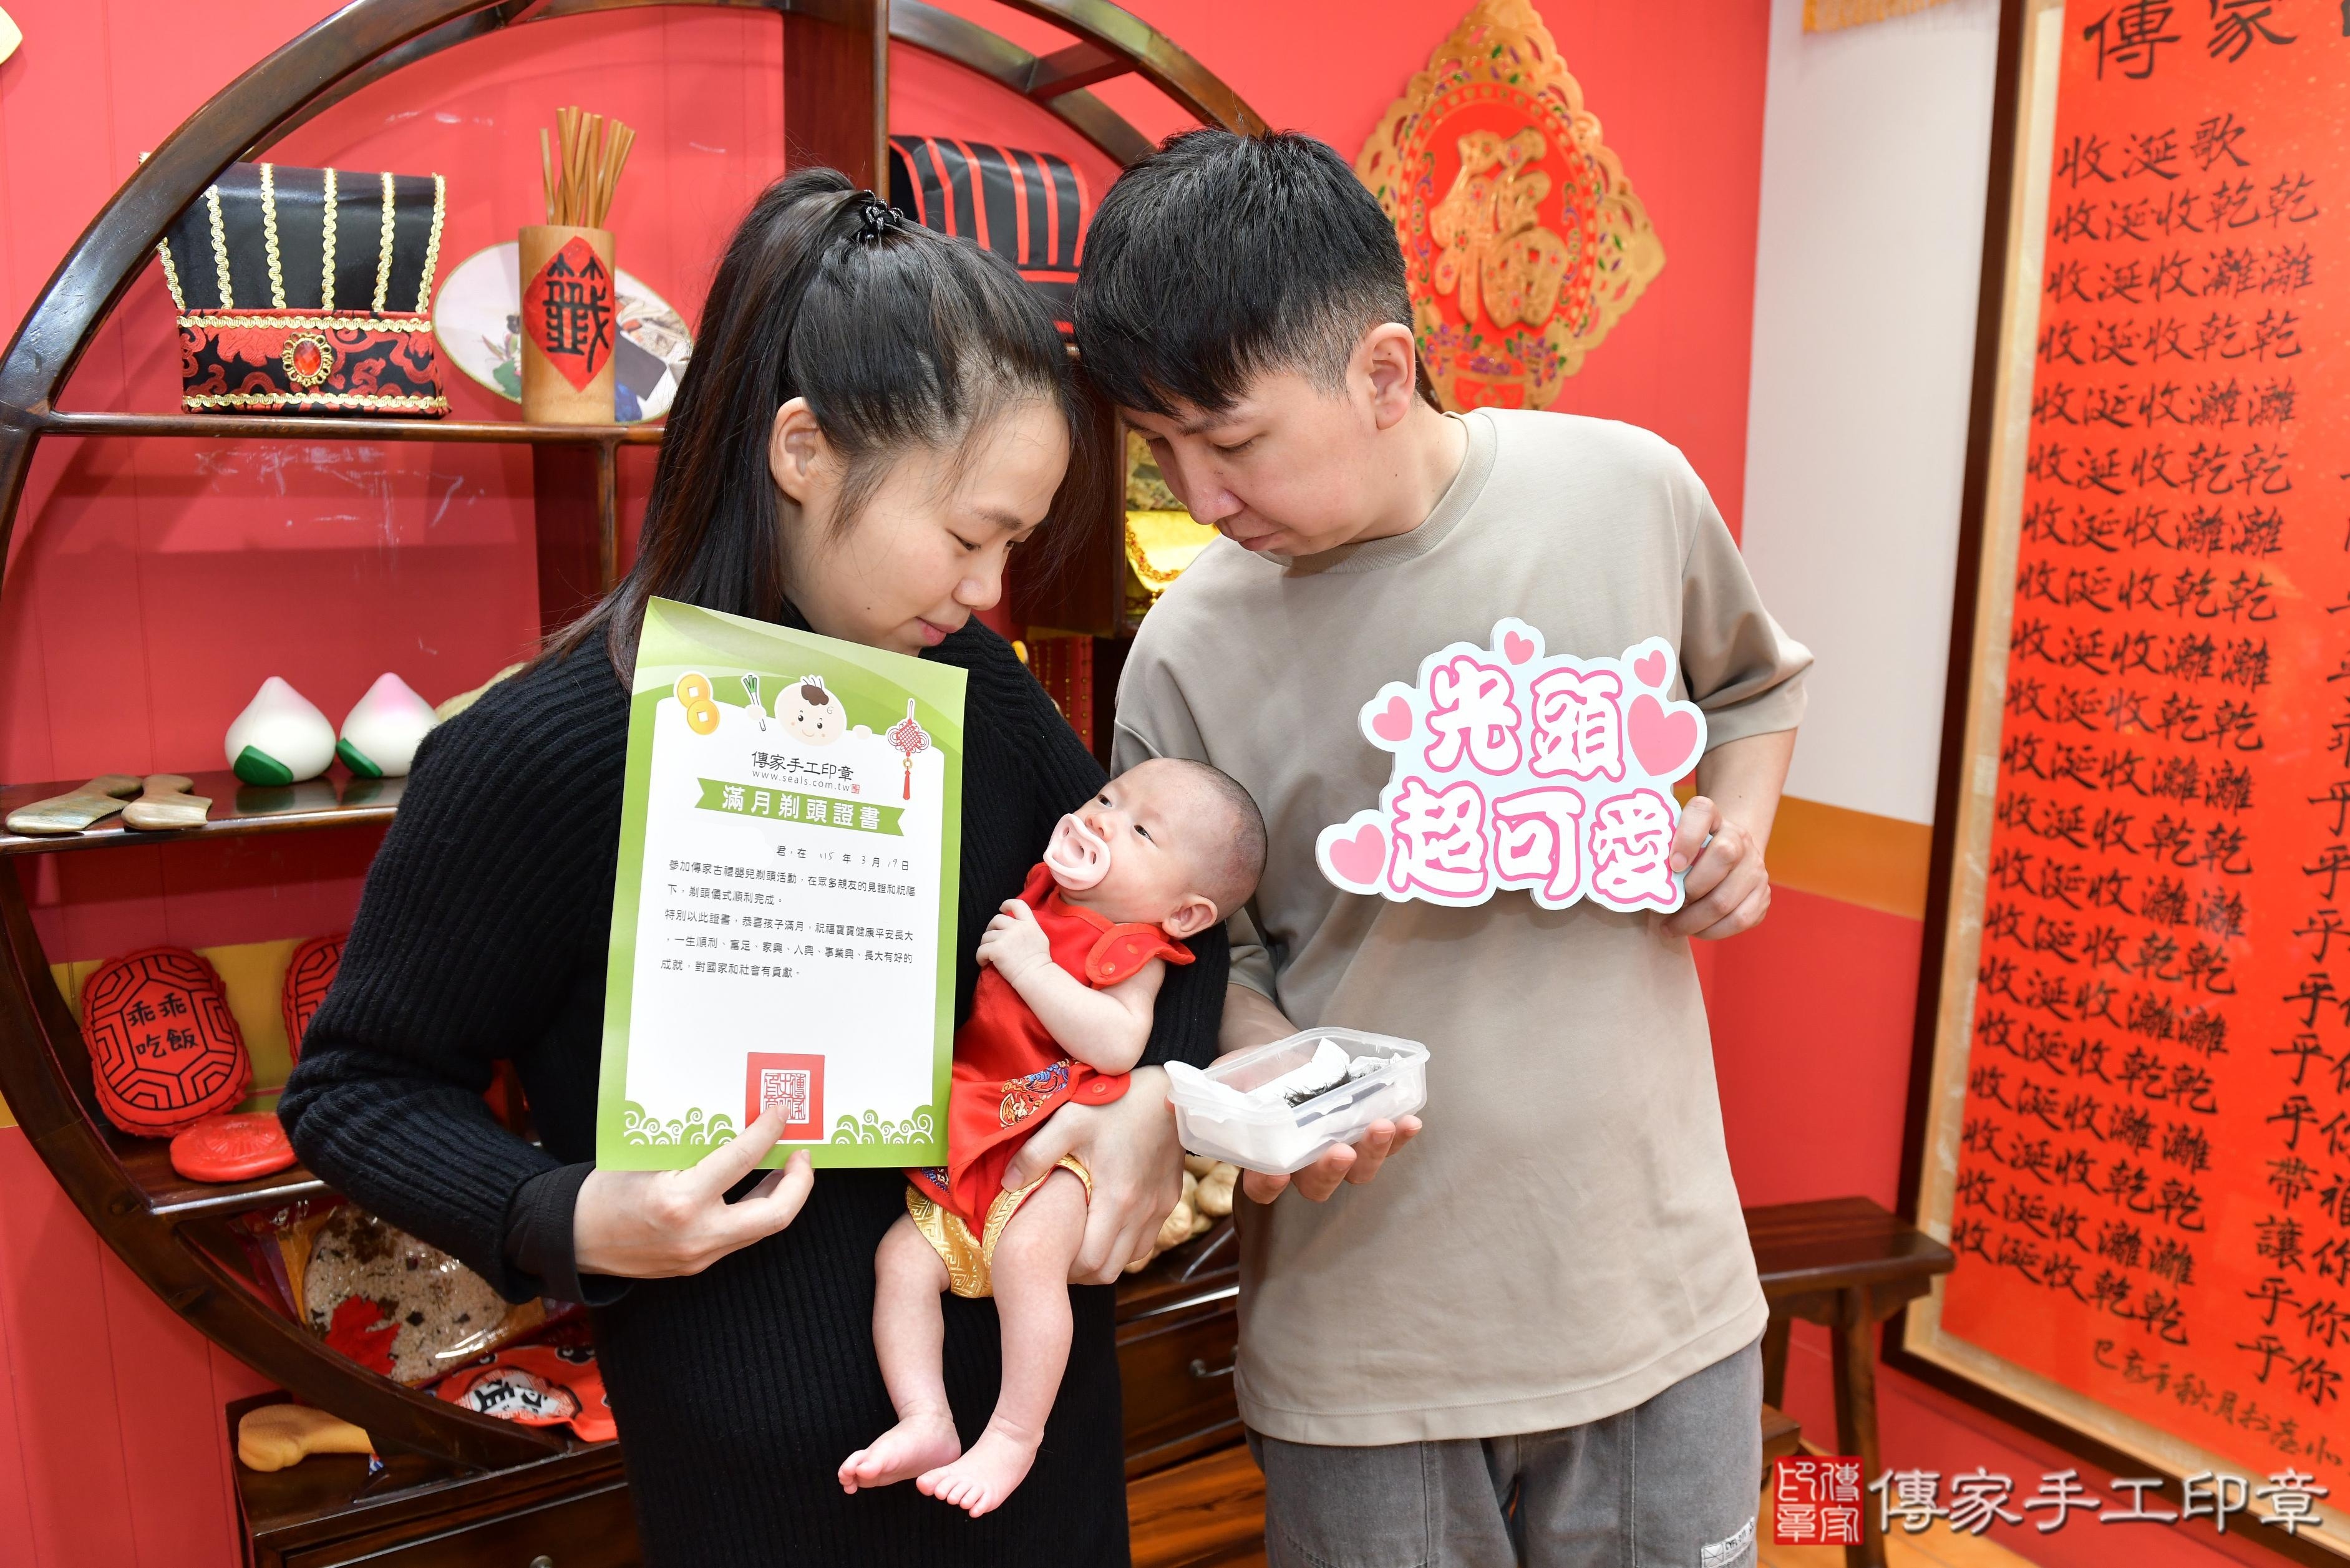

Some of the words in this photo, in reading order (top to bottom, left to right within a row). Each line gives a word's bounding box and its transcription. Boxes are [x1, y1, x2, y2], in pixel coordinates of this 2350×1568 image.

[2084, 0, 2350, 80] 傳家
[2059, 114, 2250, 188] 收涎歌
[1430, 126, 1568, 329] 福
[2055, 173, 2319, 241] 收涎收乾乾
[2038, 309, 2303, 365] 收涎收乾乾
[2027, 442, 2293, 496] 收涎收乾乾
[2017, 560, 2278, 622] 收涎收乾乾
[1424, 654, 1626, 783] 光頭
[2005, 677, 2264, 751] 收涎收乾乾
[751, 751, 855, 783] 傳家手工印章
[752, 769, 850, 793] www.seals.com.tw
[722, 784, 881, 831] 滿月剃頭證書
[1387, 775, 1677, 905] 超可愛
[1999, 791, 2252, 876] 收涎收乾乾
[842, 853, 852, 864] 年
[872, 857, 881, 868] 月
[1984, 903, 2238, 995] 收涎收乾乾
[127, 992, 187, 1027] 乖乖
[135, 1028, 199, 1059] 吃飯
